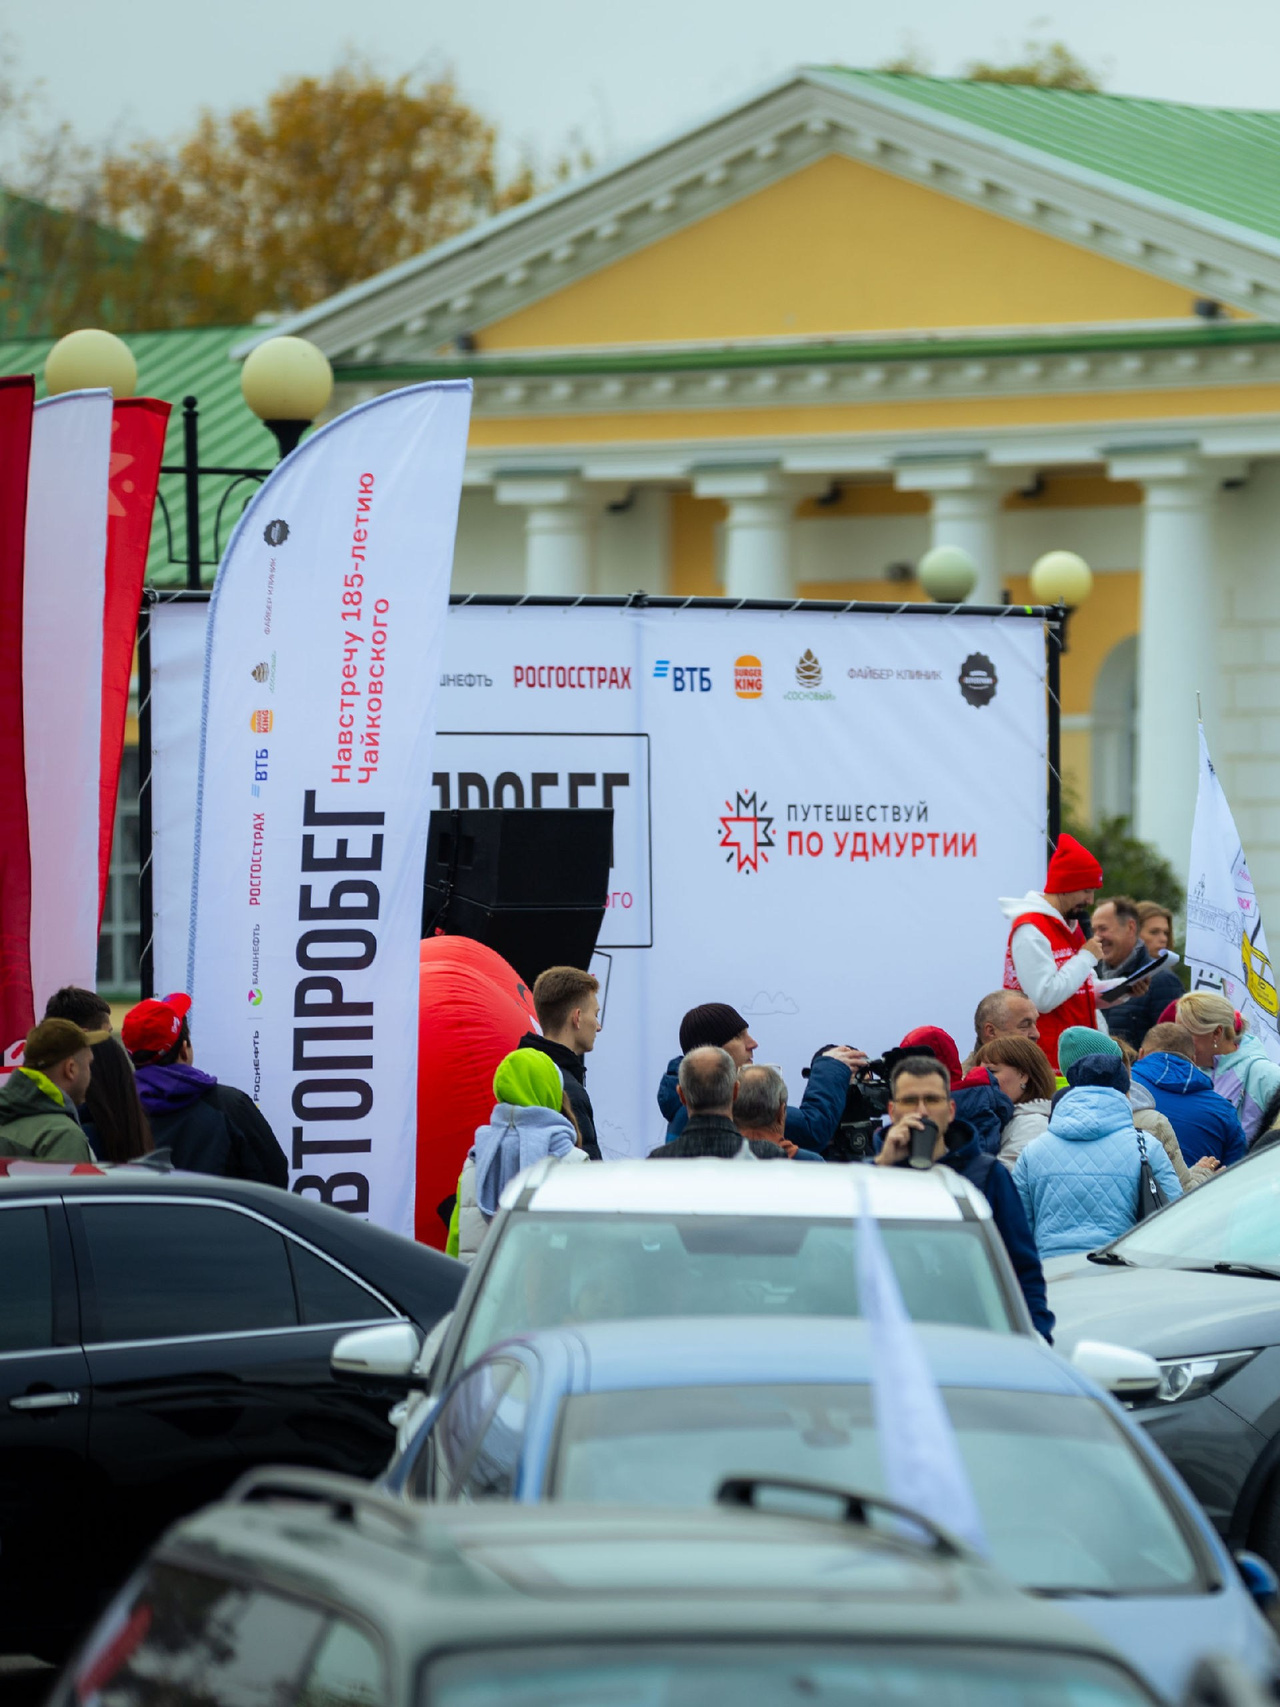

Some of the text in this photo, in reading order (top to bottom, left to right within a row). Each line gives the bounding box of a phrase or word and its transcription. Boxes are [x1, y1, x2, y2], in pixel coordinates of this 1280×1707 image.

[331, 472, 375, 784] Навстречу 185-летию
[358, 598, 390, 784] Чайковского
[439, 673, 494, 688] НЕФТЬ
[513, 665, 631, 689] РОСГОССТРАХ
[672, 667, 712, 692] ВТБ
[735, 678, 763, 691] KING
[254, 748, 269, 781] ВТБ
[787, 801, 929, 822] ПУТЕШЕСТВУЙ
[249, 812, 266, 906] РОСГОССТРАХ
[787, 831, 978, 862] ПО УДМУРТИИ
[251, 923, 262, 985] БАШНЕФТЬ
[291, 789, 385, 1221] ВТОПРОБЕГ
[252, 1030, 262, 1103] РОСНЕФТЬ
